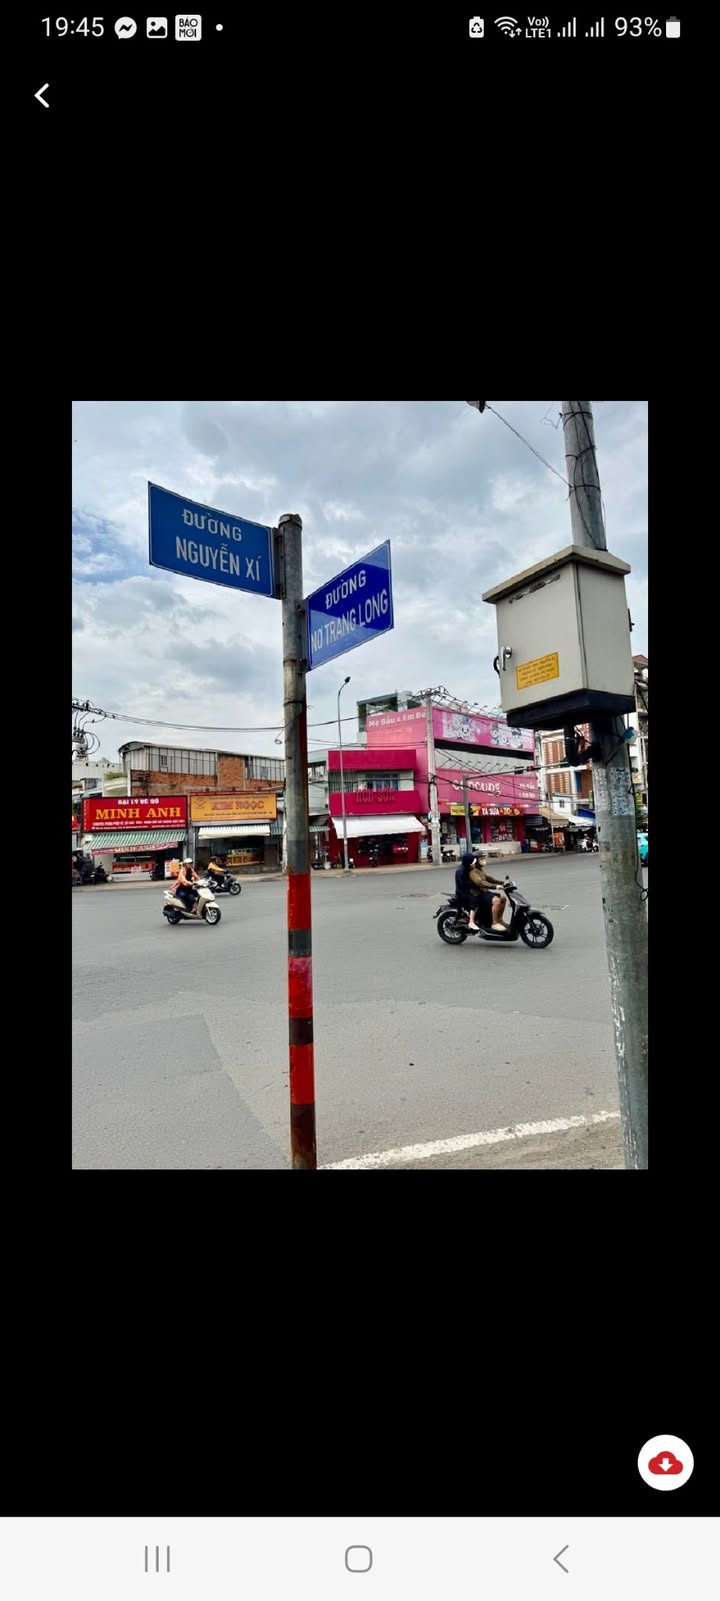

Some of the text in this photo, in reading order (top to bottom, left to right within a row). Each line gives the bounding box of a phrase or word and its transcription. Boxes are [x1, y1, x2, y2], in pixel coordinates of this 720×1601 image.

[41, 16, 105, 37] 19:45
[525, 28, 551, 38] LTE1
[614, 16, 662, 37] 93%
[181, 507, 243, 542] ĐƯỜNG
[175, 535, 262, 582] NGUYỄN XÍ
[325, 569, 367, 610] ĐƯỜNG
[324, 608, 357, 647] TRANG
[358, 588, 389, 628] LONG
[95, 807, 181, 820] MINH ANH
